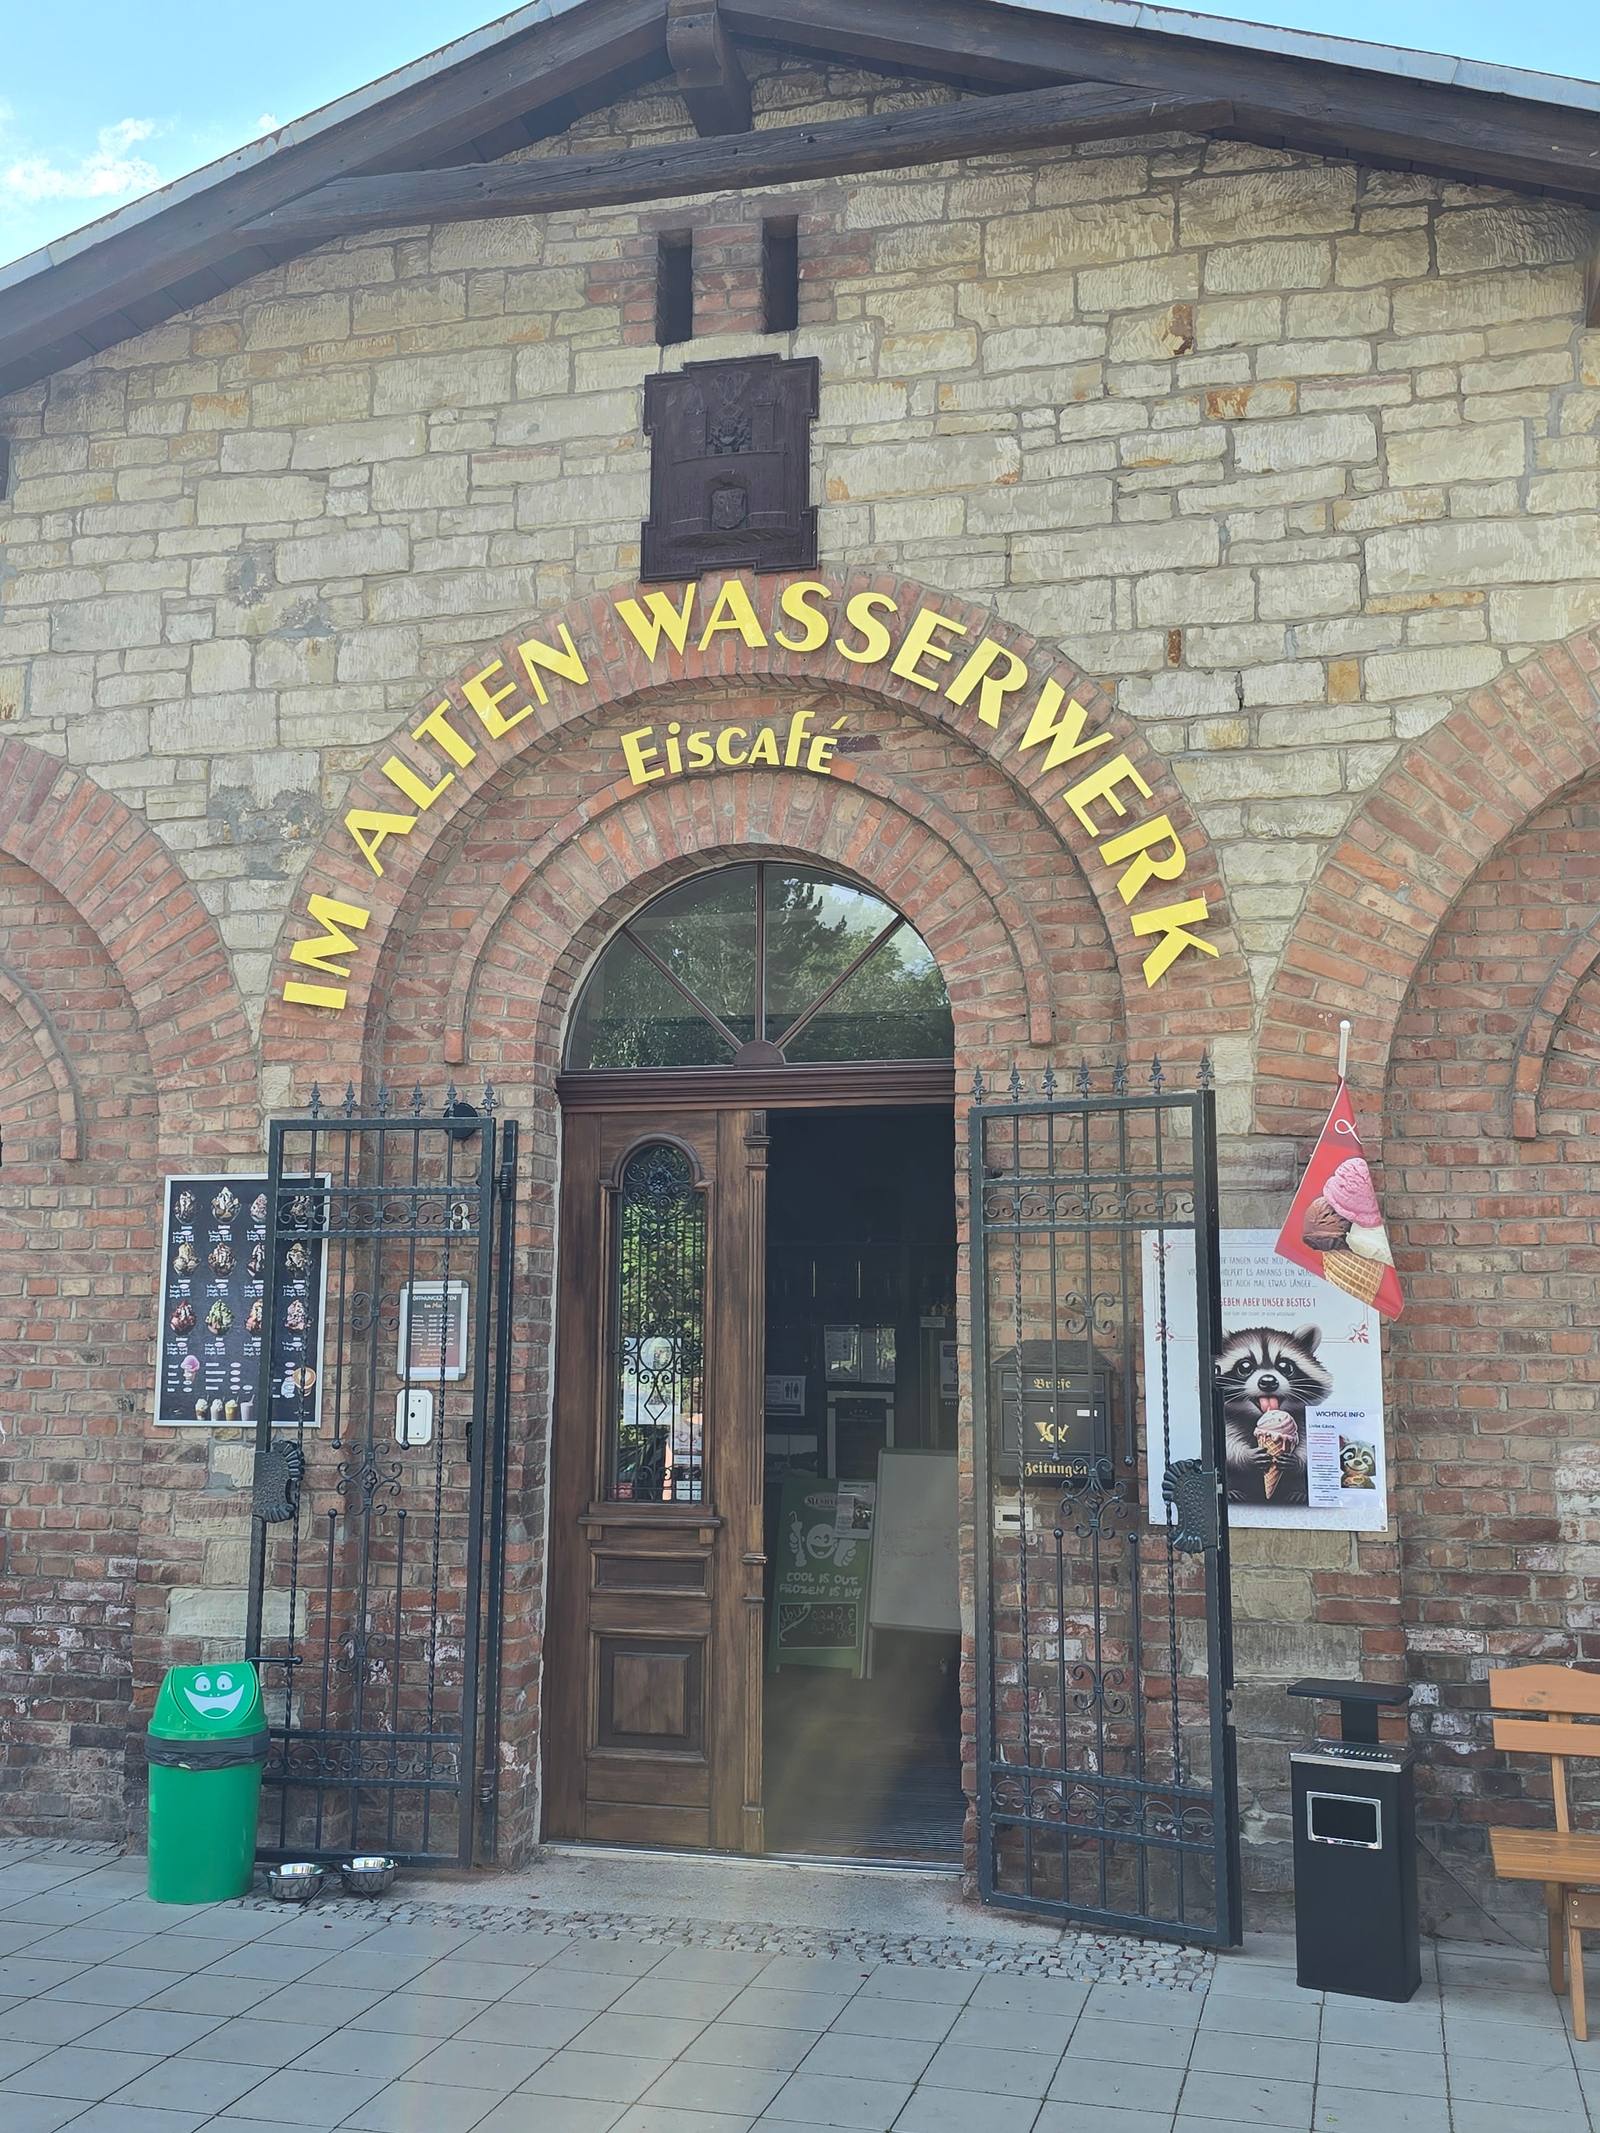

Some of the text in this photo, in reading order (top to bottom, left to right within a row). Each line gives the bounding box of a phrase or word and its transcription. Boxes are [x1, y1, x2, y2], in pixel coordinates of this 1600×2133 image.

[284, 579, 1218, 1010] IM ALTEN WASSERWERK
[1243, 1297, 1259, 1307] ABER
[1262, 1297, 1284, 1307] UNSER
[1286, 1297, 1311, 1307] BESTES
[786, 1572, 858, 1585] COOL IS OUT
[779, 1584, 825, 1595] FROZEN
[829, 1586, 841, 1597] IS
